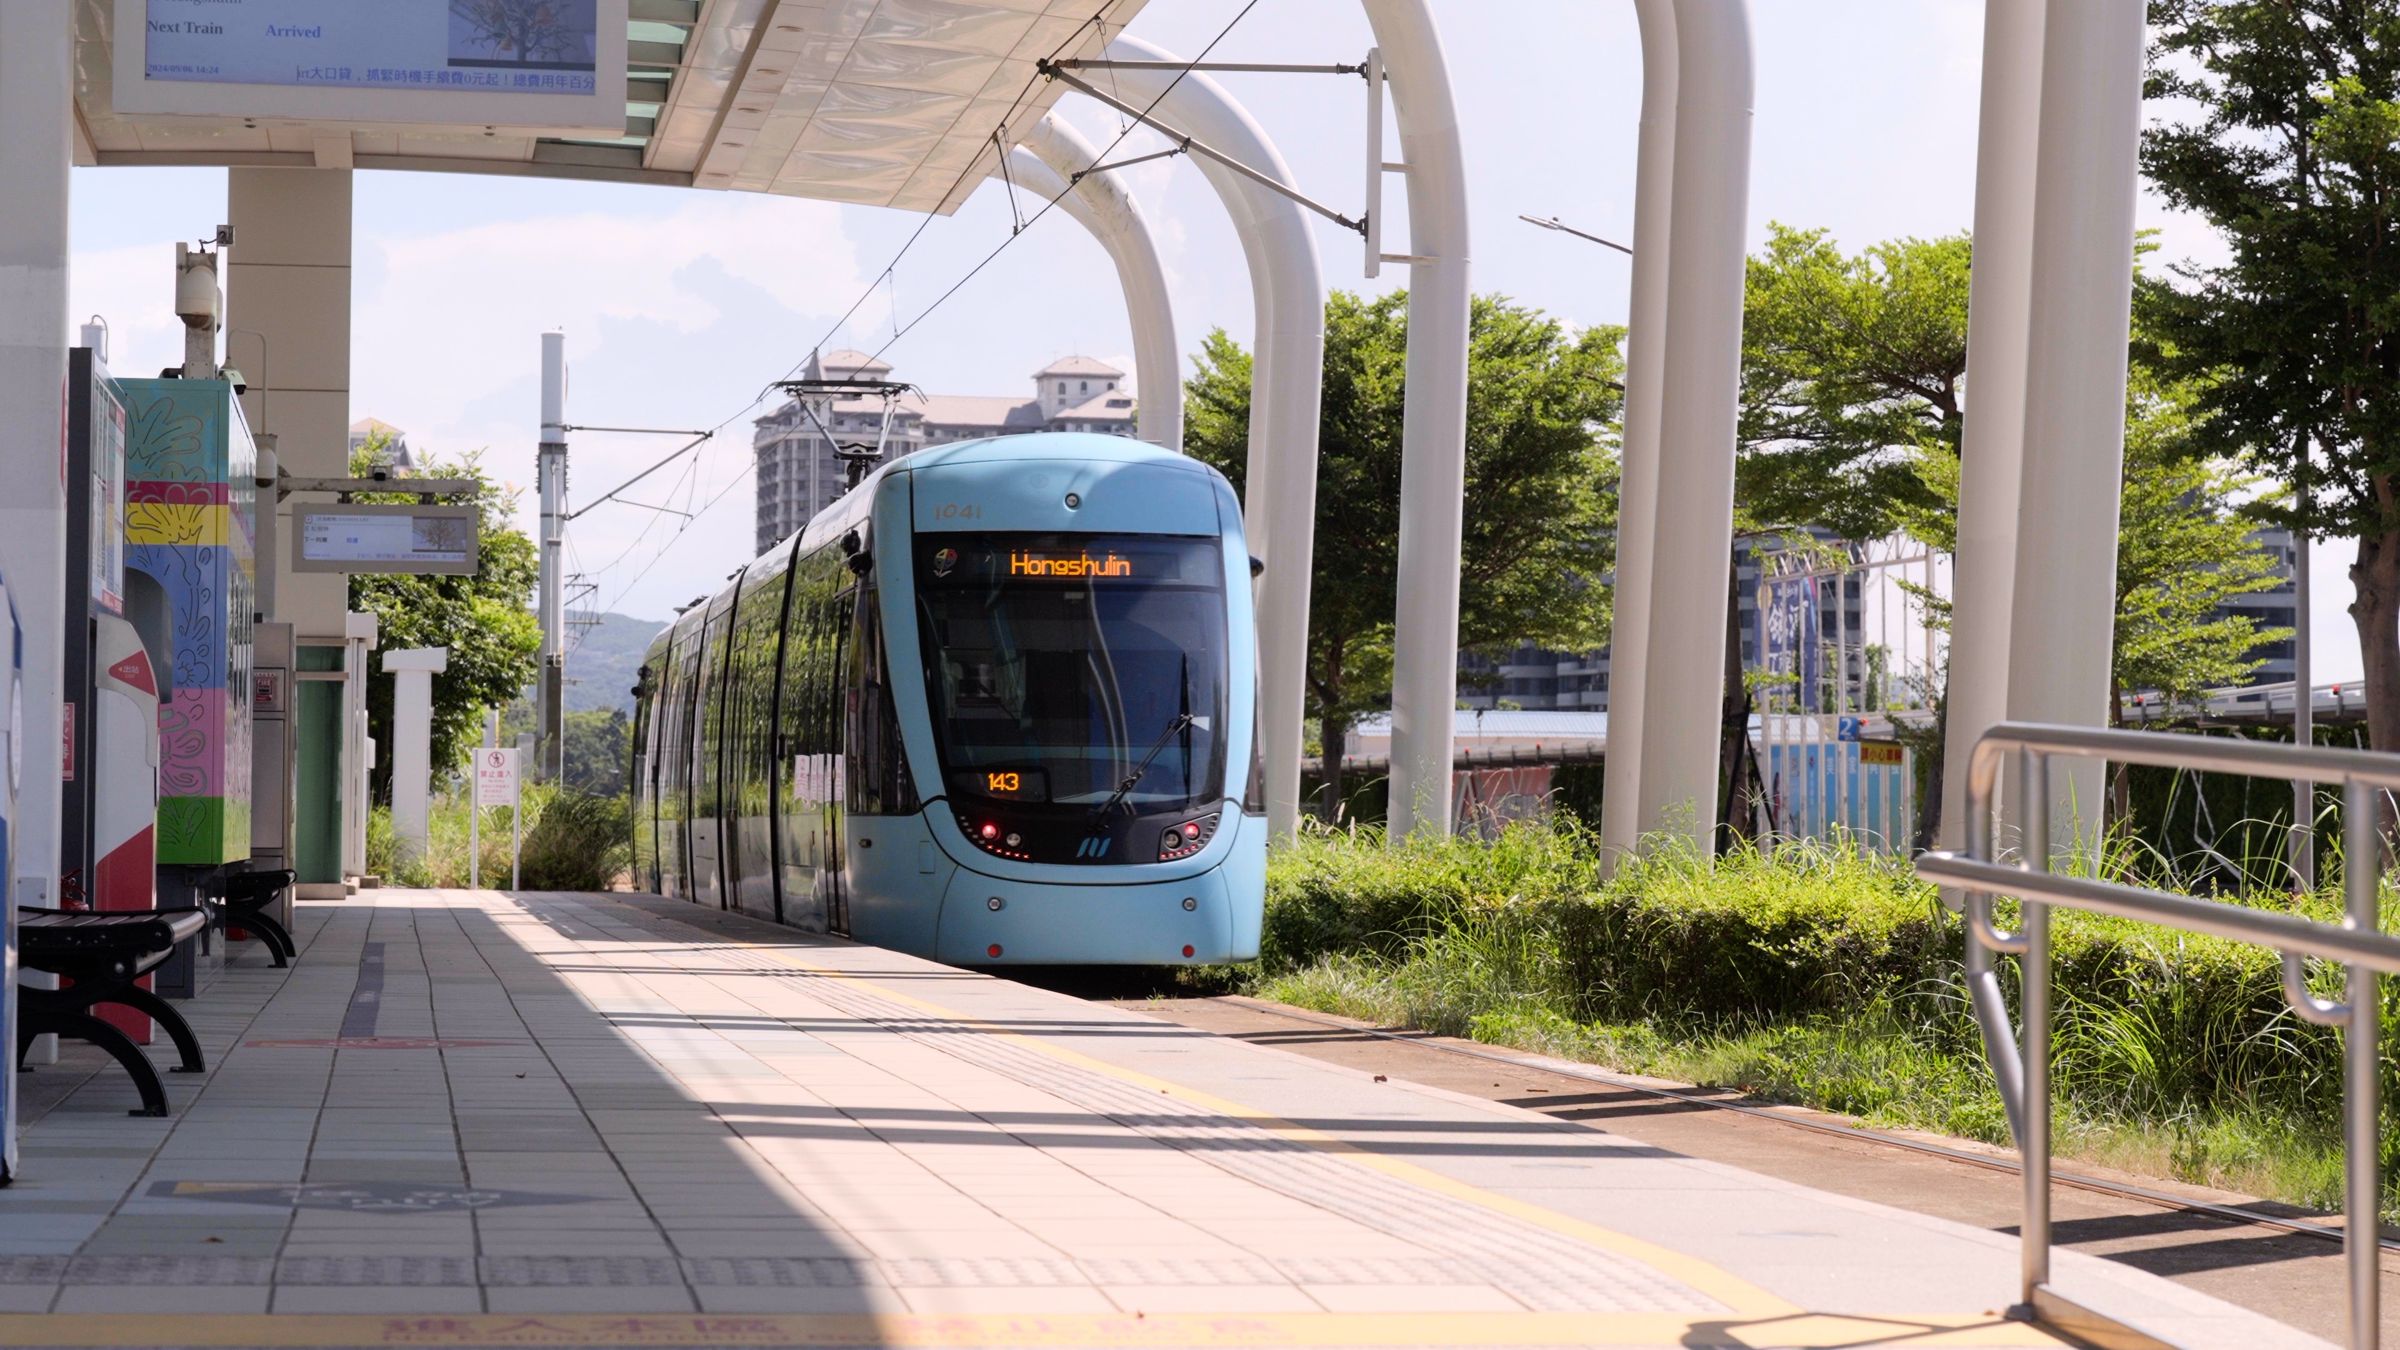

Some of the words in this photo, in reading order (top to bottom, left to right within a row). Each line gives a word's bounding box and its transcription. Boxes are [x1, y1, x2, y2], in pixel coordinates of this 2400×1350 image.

[148, 20, 180, 33] Next
[184, 21, 223, 35] Train
[265, 24, 321, 39] Arrived
[934, 503, 981, 520] 1041
[1011, 551, 1131, 576] Hongshulin
[1840, 718, 1852, 736] 2
[988, 773, 1019, 791] 143
